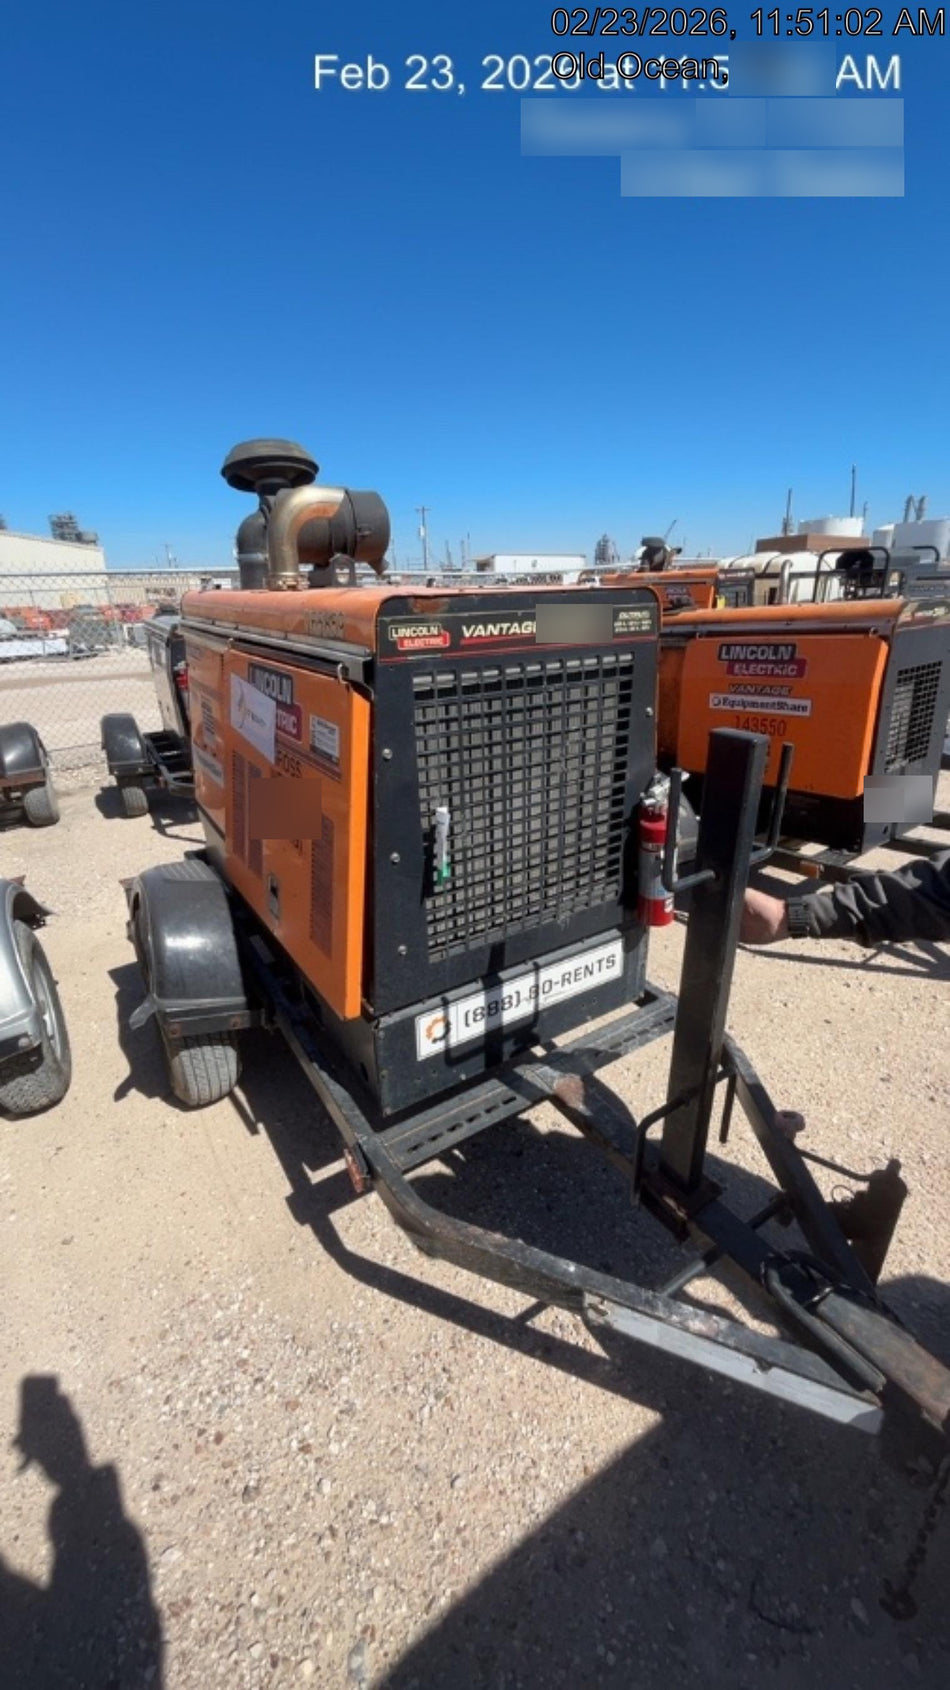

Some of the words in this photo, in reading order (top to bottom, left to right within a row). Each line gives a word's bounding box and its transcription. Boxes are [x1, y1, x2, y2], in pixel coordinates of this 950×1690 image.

[391, 626, 439, 638] LINCOLN
[462, 621, 536, 638] VANTAG
[721, 645, 793, 661] LINCOLN
[733, 663, 798, 676] ELECTRIC
[728, 683, 793, 697] VANTAGE
[722, 697, 808, 713] EquipmentShare
